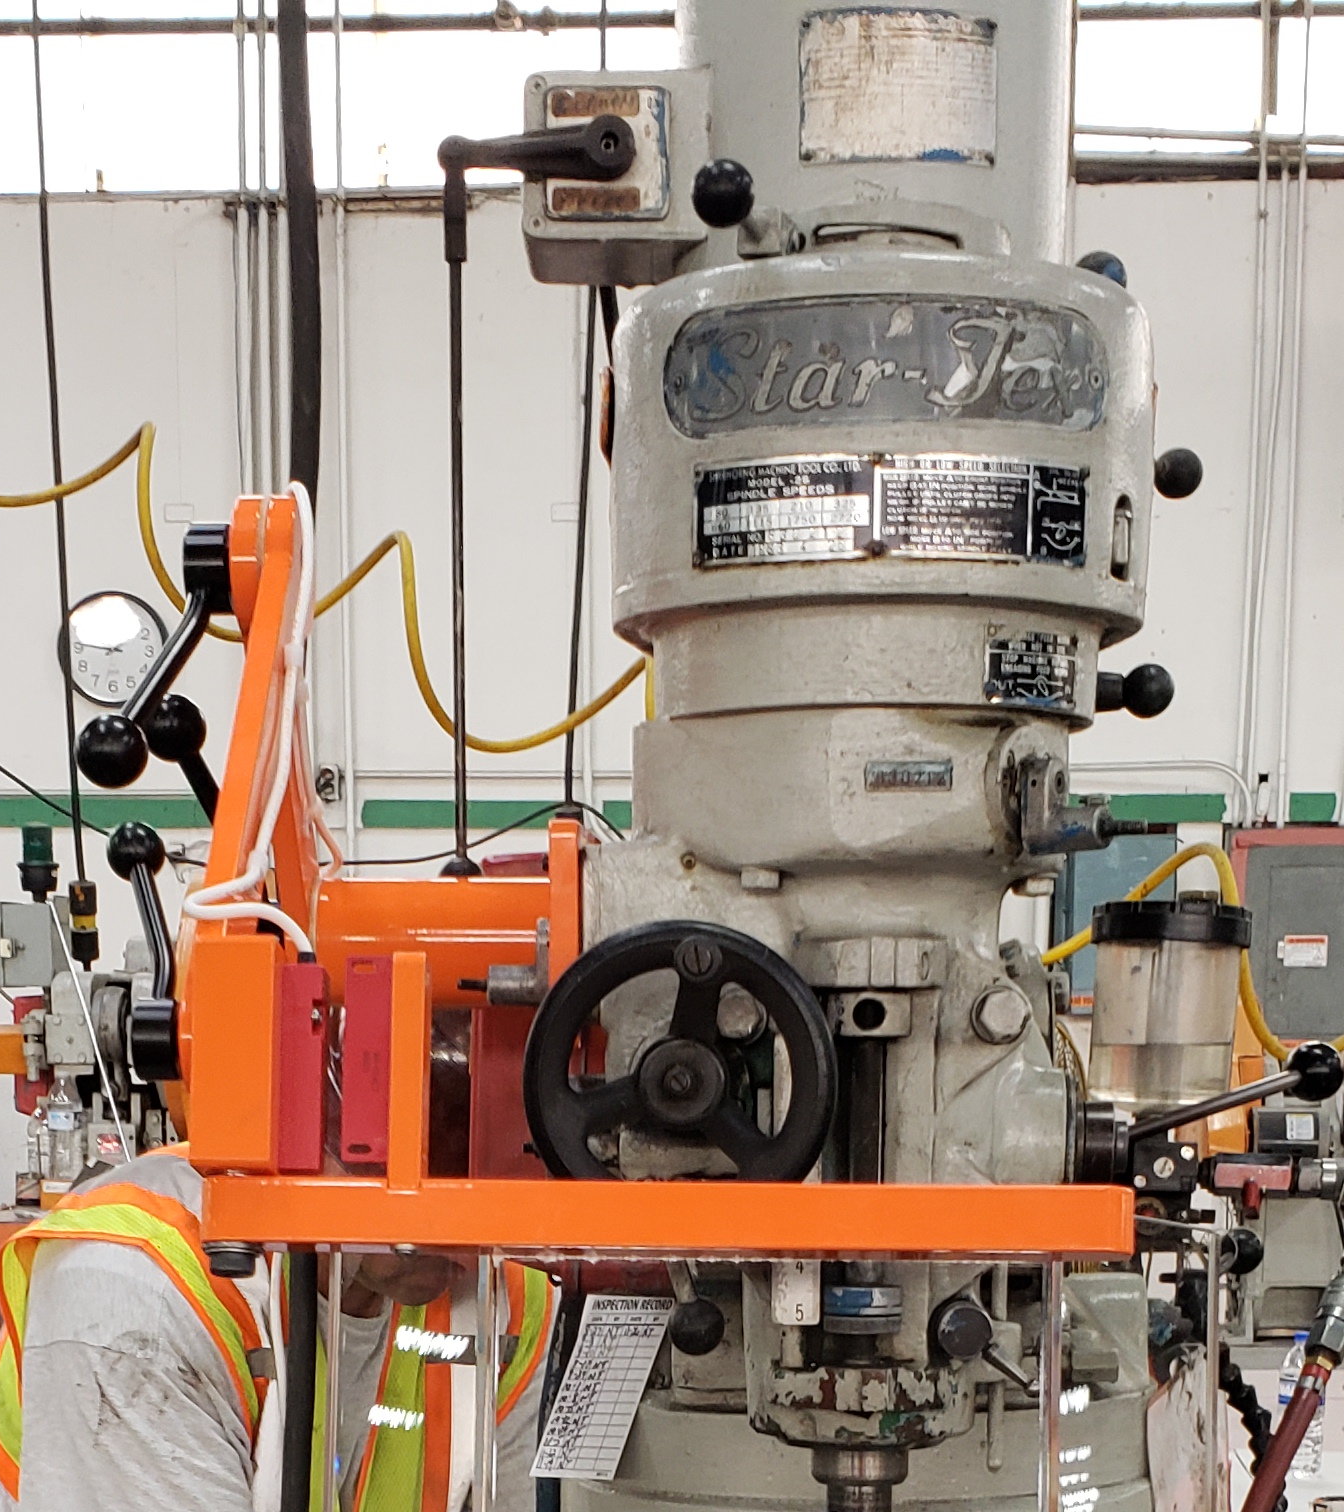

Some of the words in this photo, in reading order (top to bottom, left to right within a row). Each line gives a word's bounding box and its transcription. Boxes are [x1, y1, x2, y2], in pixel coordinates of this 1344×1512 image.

[748, 476, 785, 488] MODEL
[726, 487, 777, 501] SPINDLE
[783, 484, 835, 497] SPEEDS
[712, 533, 742, 547] SERIAL
[712, 545, 744, 559] DATE
[141, 628, 150, 640] 2
[145, 645, 154, 658] 3
[78, 660, 88, 672] 8
[91, 674, 100, 687] 7
[108, 681, 118, 693] 6
[126, 676, 136, 688] 5
[796, 1261, 804, 1274] 4
[592, 1298, 639, 1311] INSPECTION
[640, 1299, 673, 1311] RECORD
[795, 1303, 804, 1322] 5
